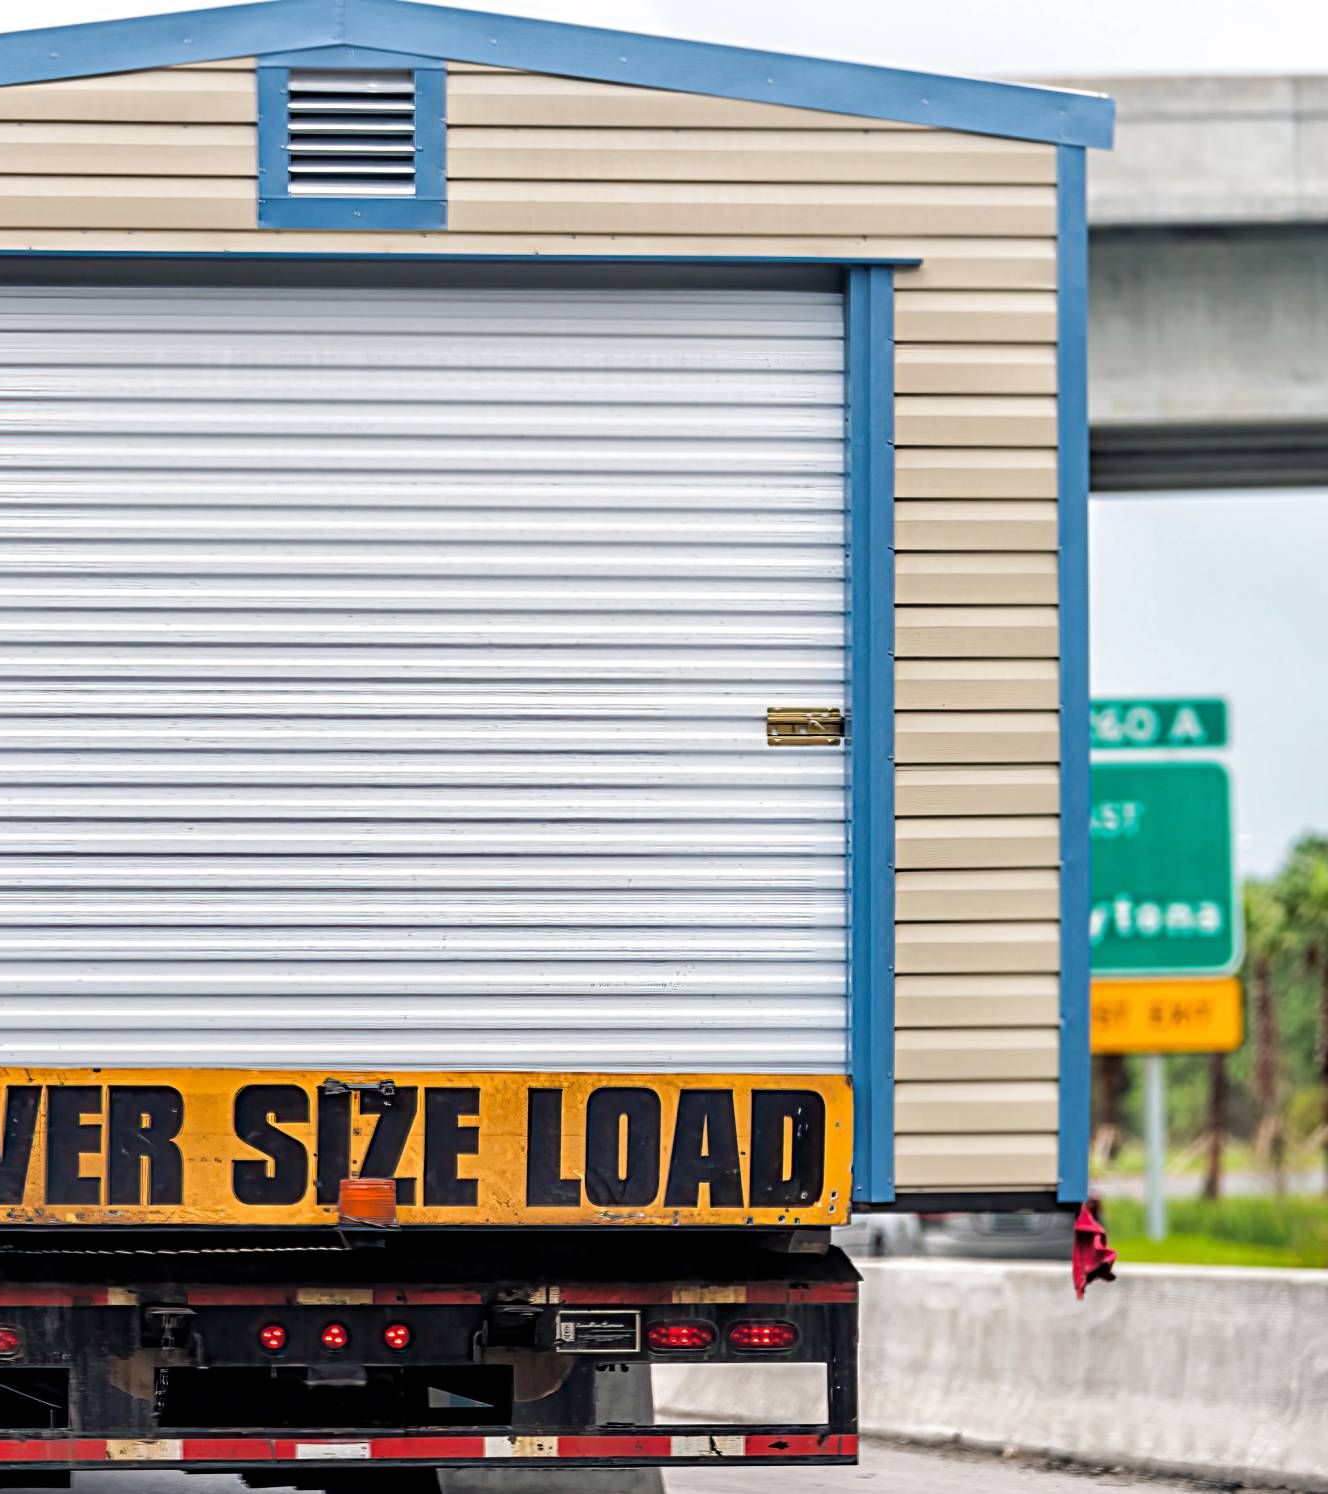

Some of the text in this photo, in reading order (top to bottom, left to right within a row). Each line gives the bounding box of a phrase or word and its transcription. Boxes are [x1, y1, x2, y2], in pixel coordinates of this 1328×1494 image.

[1090, 705, 1206, 741] 60 A
[232, 1083, 480, 1207] SIZE
[526, 1086, 826, 1209] LOAD
